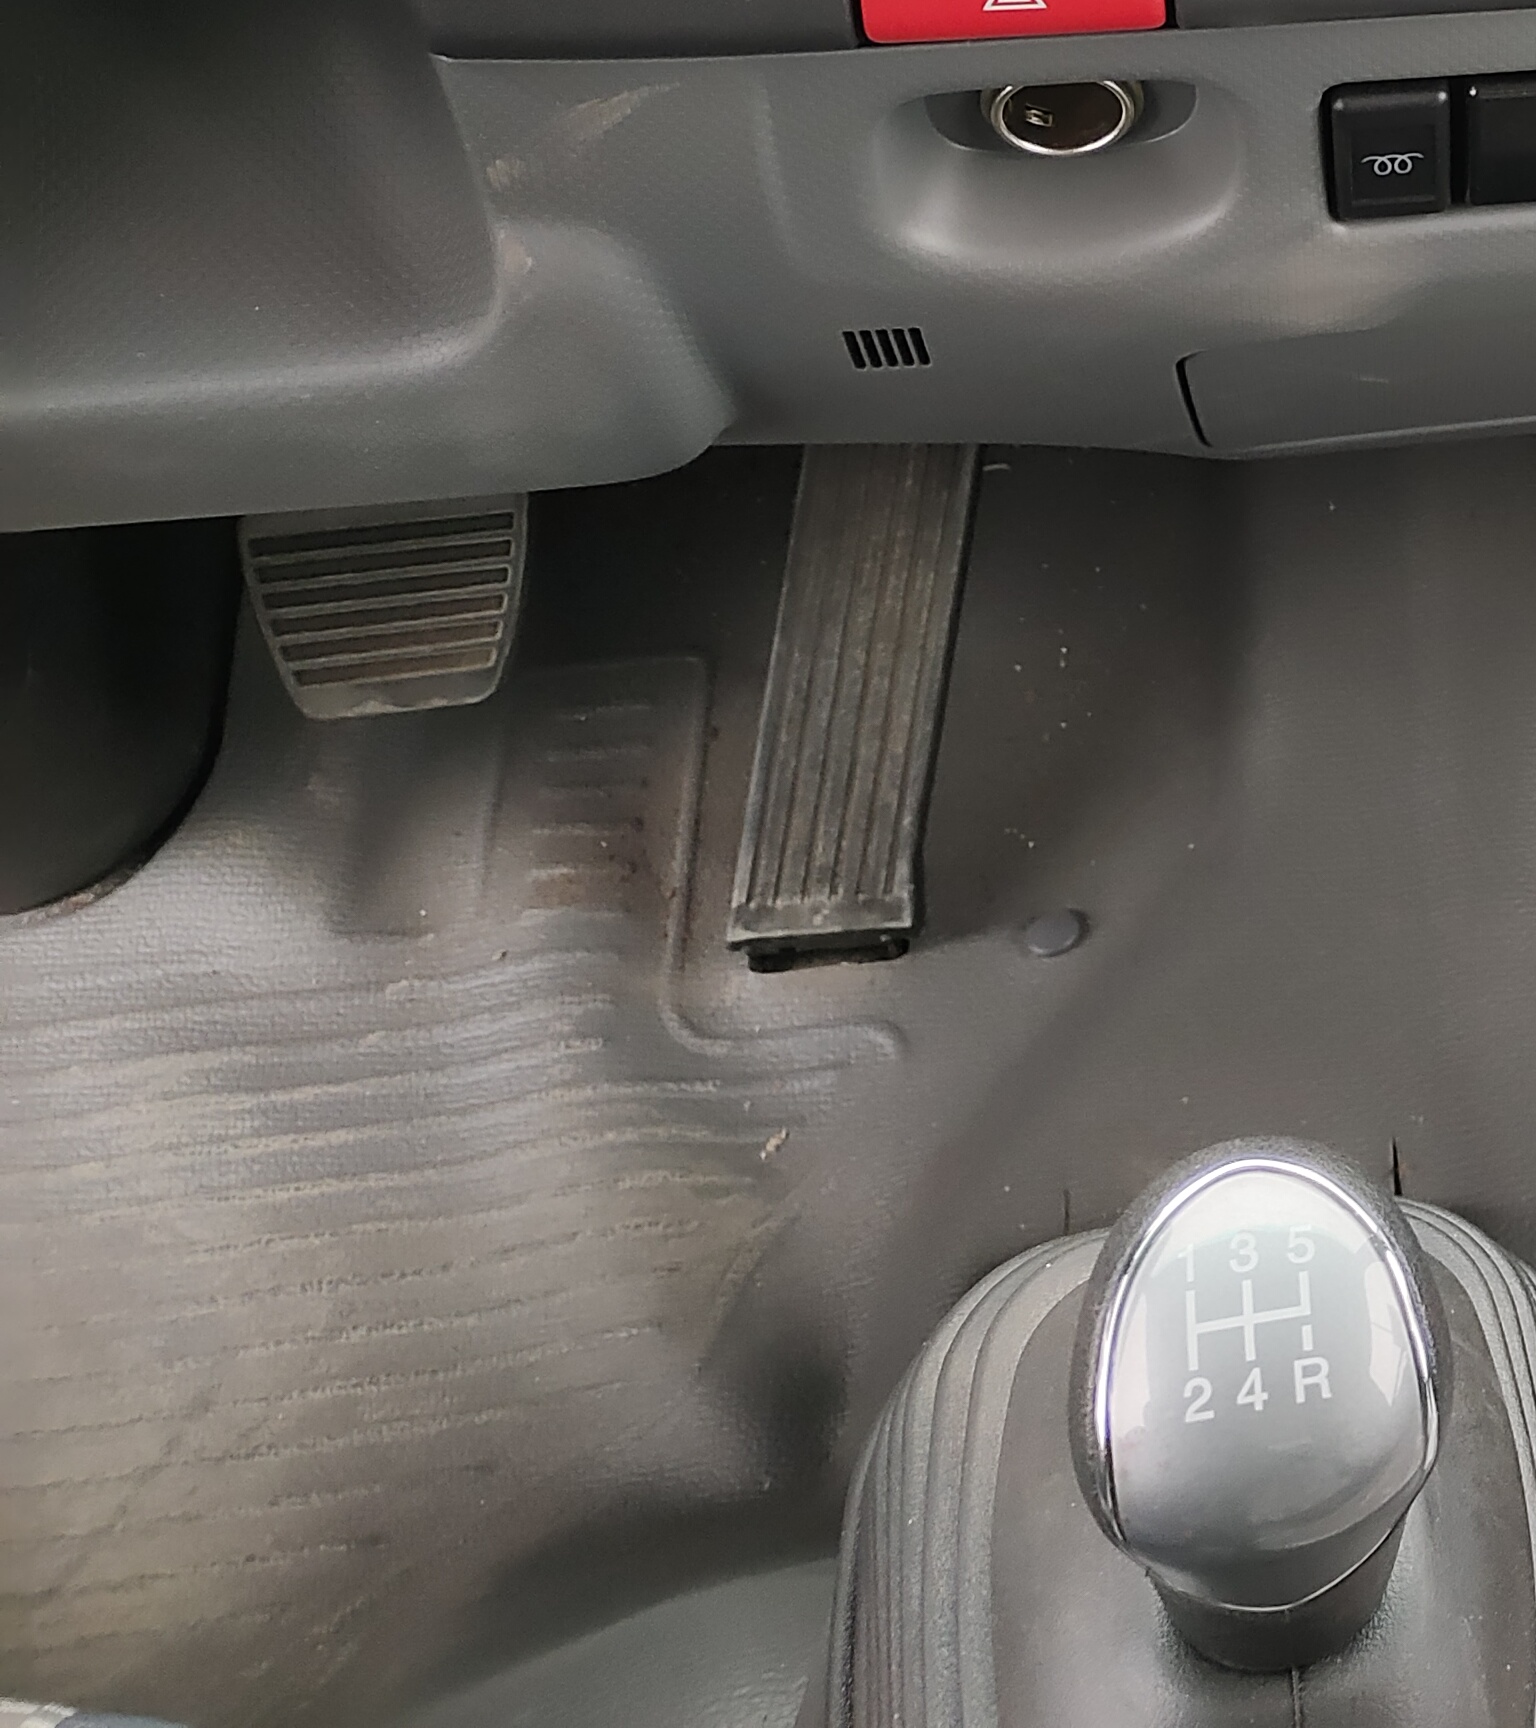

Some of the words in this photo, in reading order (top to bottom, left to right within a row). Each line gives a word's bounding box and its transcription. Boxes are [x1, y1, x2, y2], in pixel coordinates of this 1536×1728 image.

[1177, 1242, 1196, 1282] 1
[1228, 1232, 1261, 1273] 3
[1286, 1224, 1316, 1264] 5
[1183, 1377, 1215, 1423] 2
[1236, 1368, 1269, 1411] 4
[1293, 1356, 1333, 1404] R
